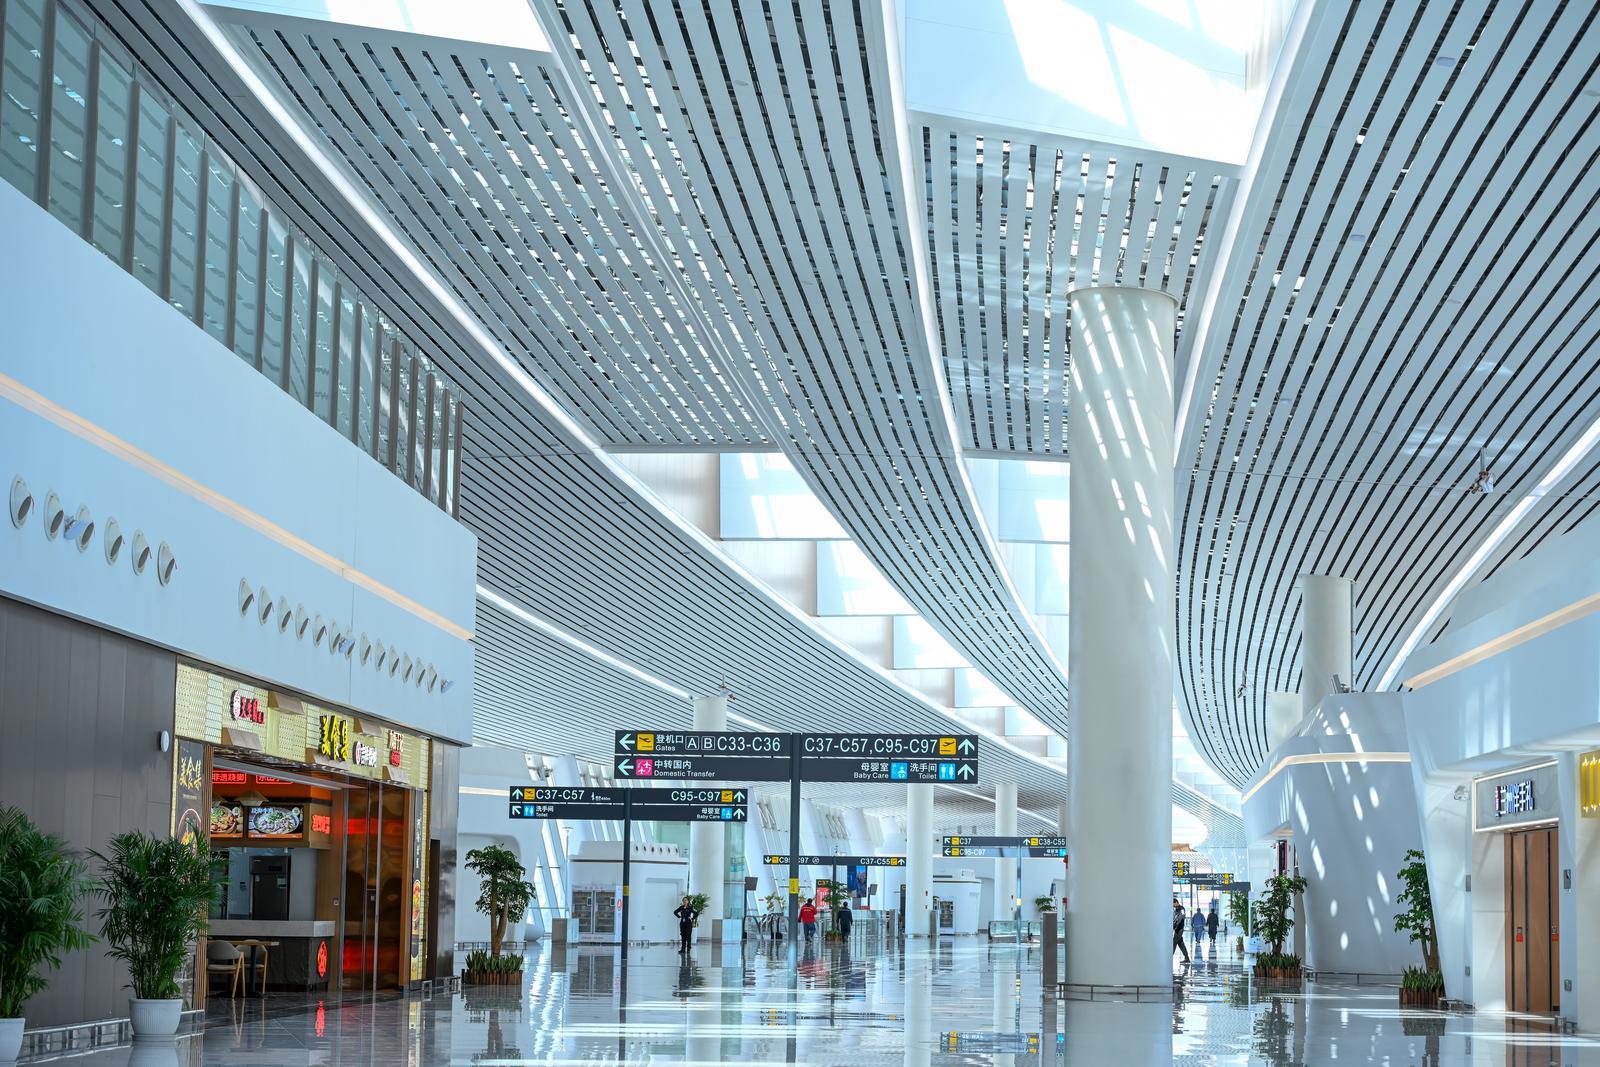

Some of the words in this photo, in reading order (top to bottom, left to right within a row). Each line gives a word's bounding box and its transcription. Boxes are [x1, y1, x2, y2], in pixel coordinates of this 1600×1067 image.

[656, 734, 684, 744] 登机口
[717, 736, 781, 751] C33-C36
[805, 737, 938, 755] C37-C57,C95-C97
[655, 744, 676, 752] Gates
[654, 760, 692, 770] 中转国内
[861, 762, 889, 772] 母婴室
[910, 762, 937, 772] 洗手间
[853, 772, 871, 780] Baby
[536, 789, 585, 800] C37-C57
[671, 790, 721, 801] C95-C97
[1038, 838, 1066, 846] C38-C55
[860, 857, 891, 865] C37-C55
